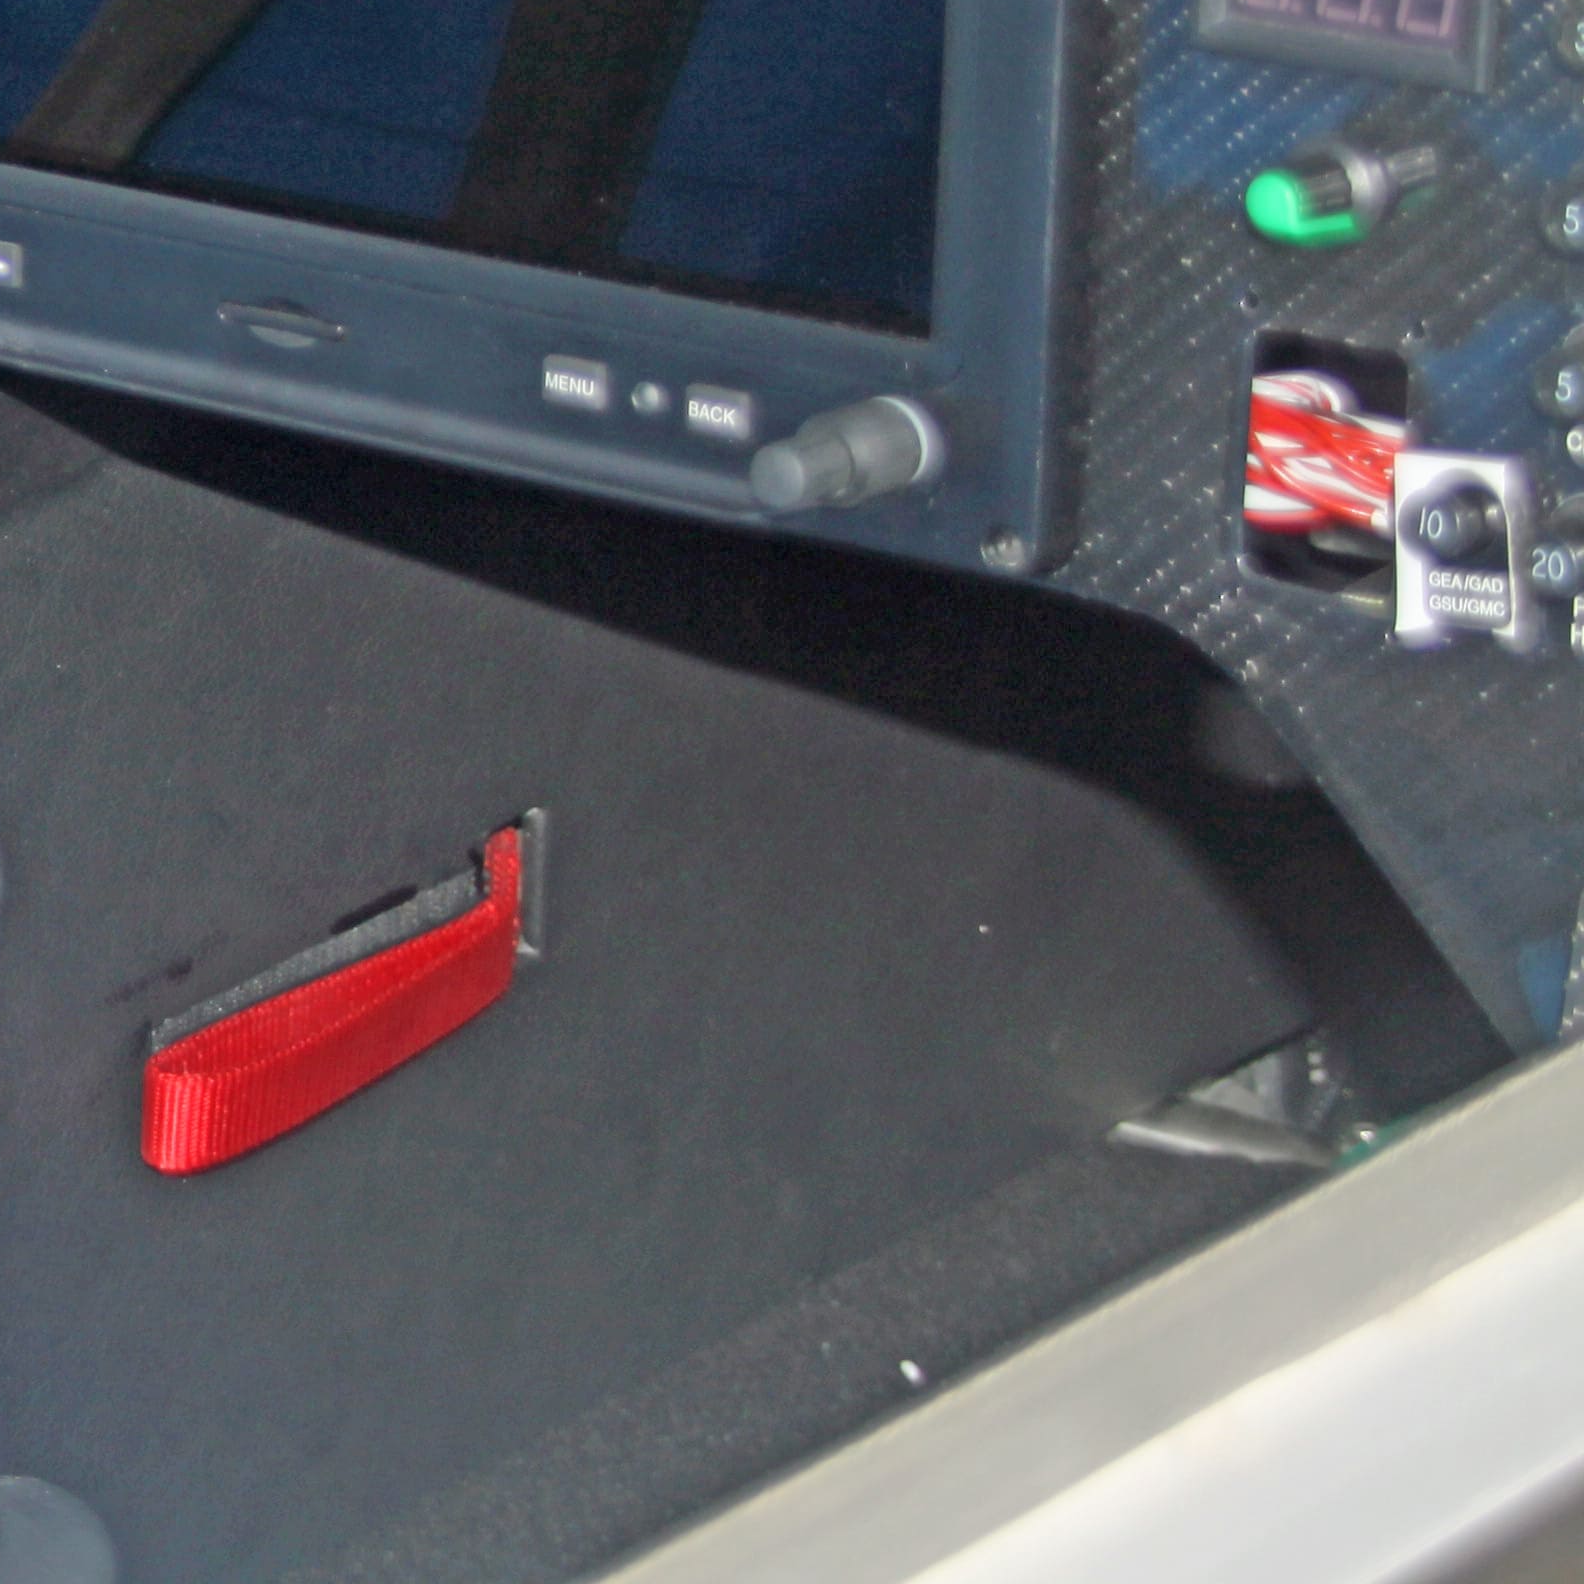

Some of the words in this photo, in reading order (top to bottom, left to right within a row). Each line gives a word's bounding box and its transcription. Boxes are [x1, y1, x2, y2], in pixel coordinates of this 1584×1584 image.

[1562, 203, 1580, 234] 5
[544, 371, 595, 397] MENU
[1554, 371, 1573, 403] 5
[687, 399, 736, 426] BACK
[1418, 505, 1445, 538] 10
[1531, 547, 1565, 581] 20
[1428, 594, 1506, 618] GSU/GMC
